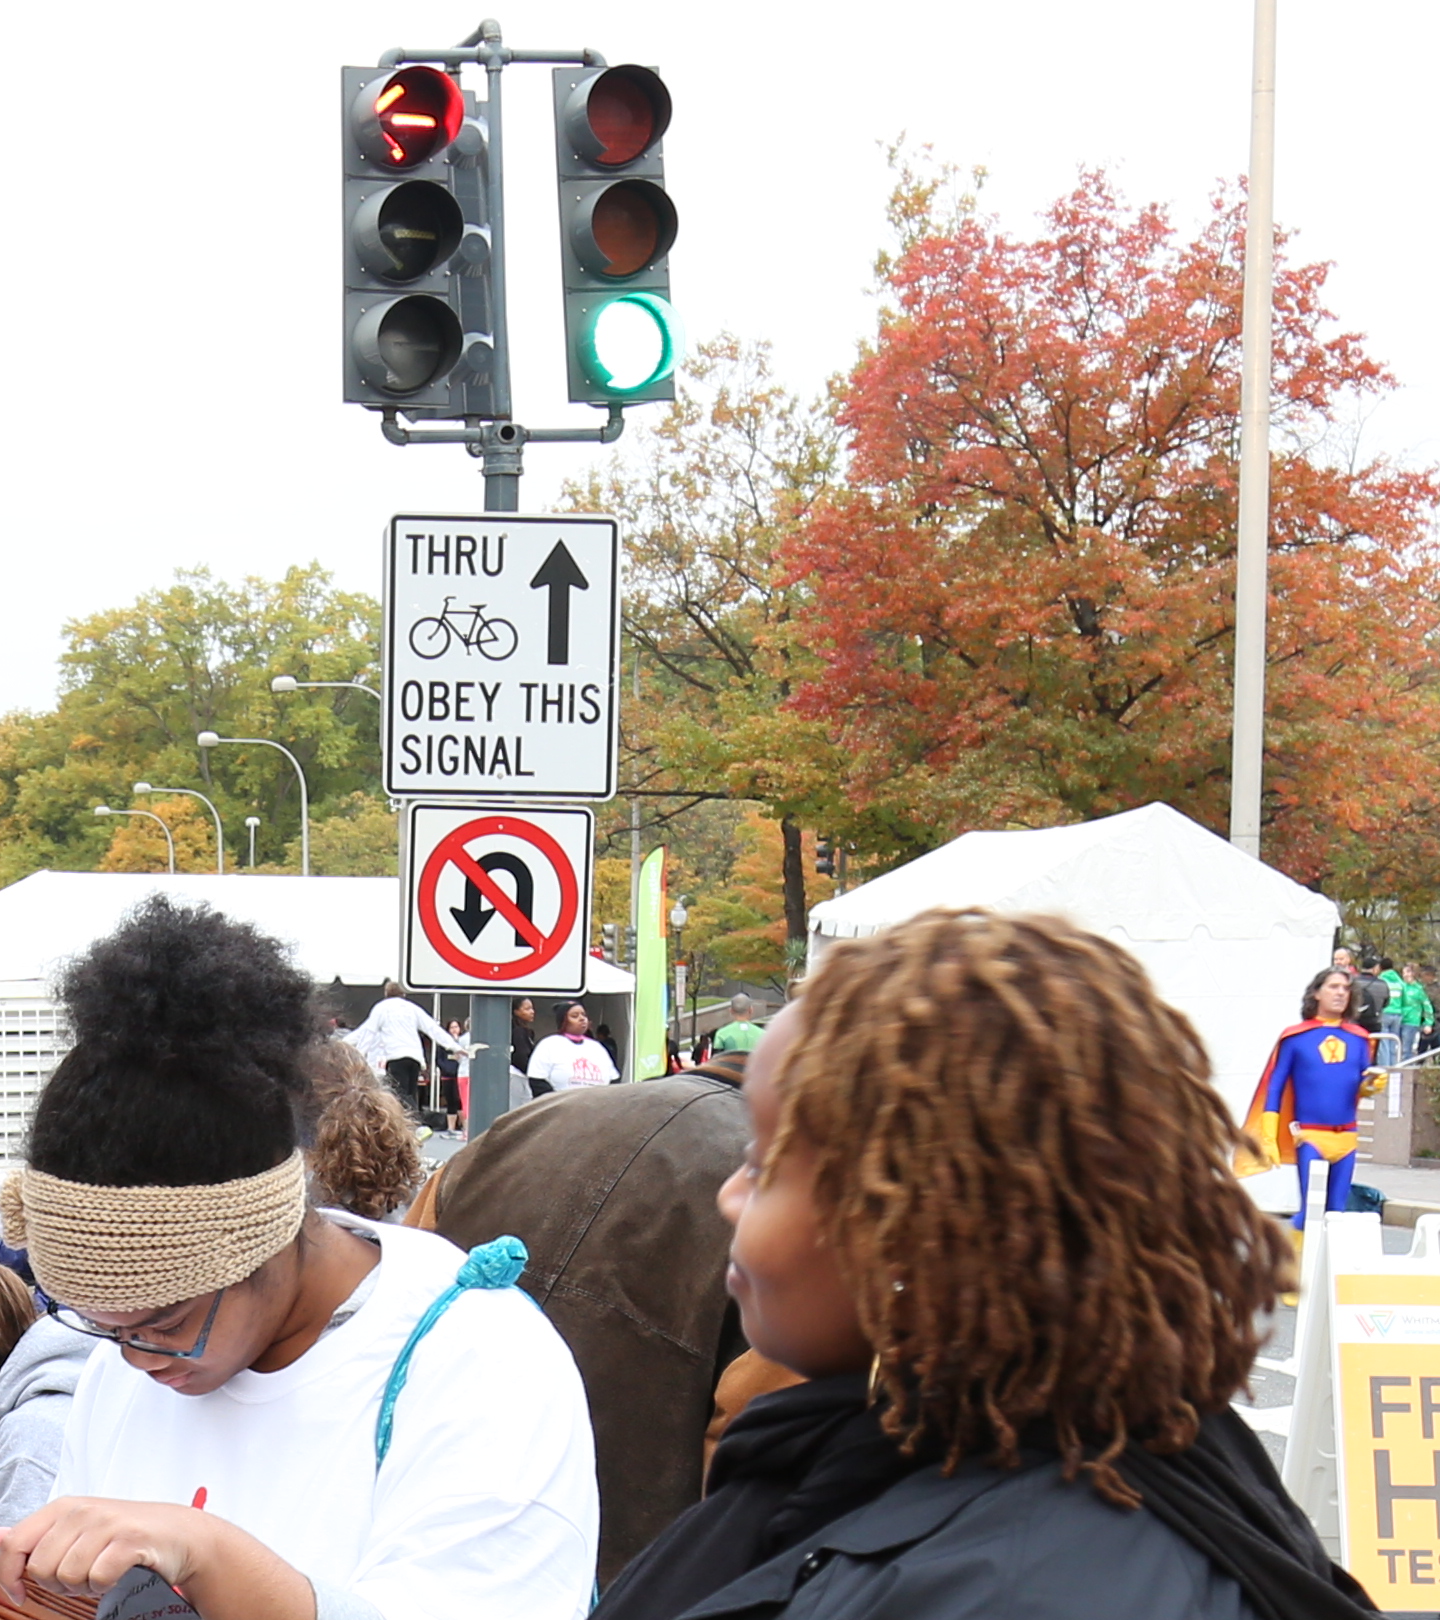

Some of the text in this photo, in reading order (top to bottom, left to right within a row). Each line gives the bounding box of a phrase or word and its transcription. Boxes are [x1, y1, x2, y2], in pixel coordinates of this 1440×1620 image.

[405, 534, 505, 577] THRU
[401, 681, 601, 725] OBEY THIS
[400, 734, 535, 777] SIGNAL
